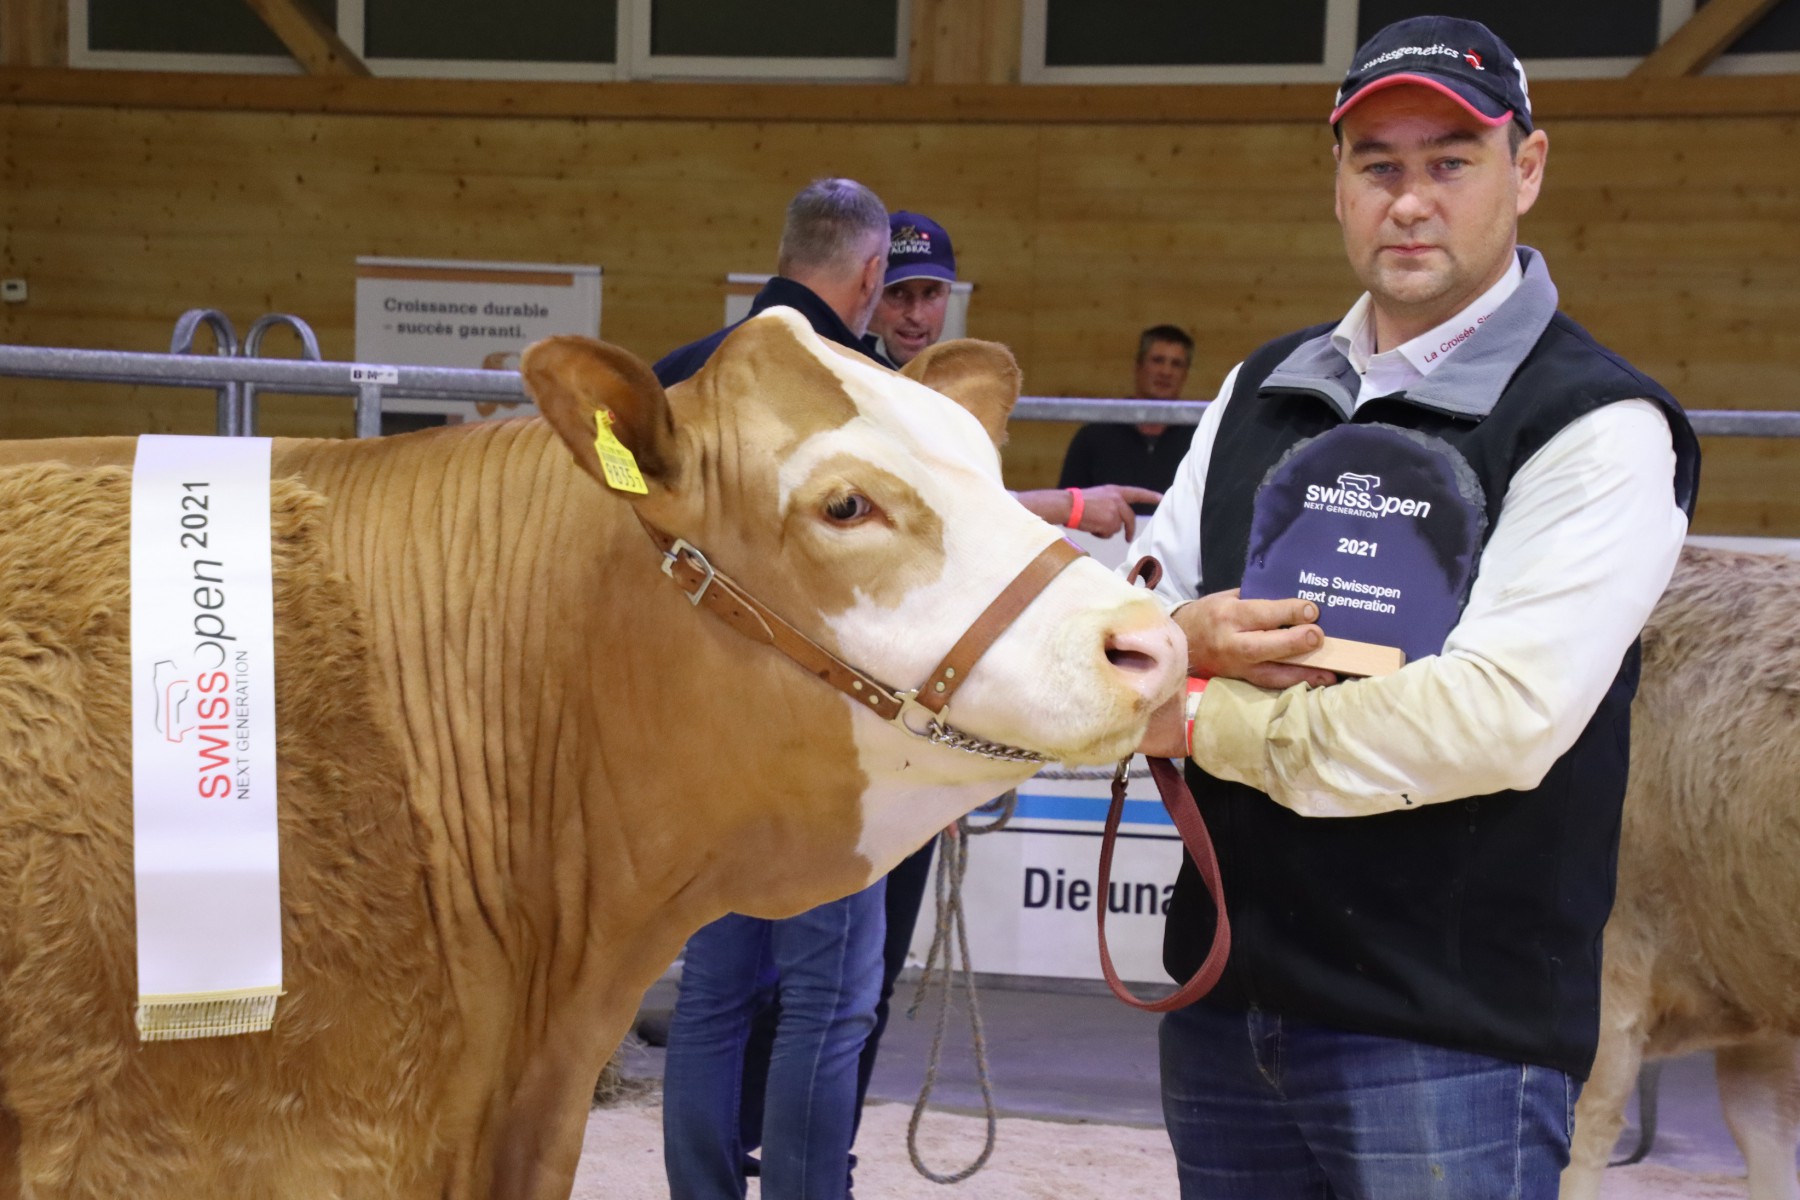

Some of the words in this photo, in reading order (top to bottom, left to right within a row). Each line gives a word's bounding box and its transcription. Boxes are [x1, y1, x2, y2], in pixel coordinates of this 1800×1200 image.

[384, 297, 478, 315] Croissance
[483, 301, 549, 318] durable
[397, 321, 453, 336] succès
[458, 324, 527, 340] garanti.
[1424, 351, 1438, 363] La
[180, 482, 210, 549] 2021
[1303, 501, 1324, 511] NEXT
[1325, 503, 1379, 519] GENERATION
[1336, 537, 1378, 557] 2021
[1299, 570, 1329, 587] Miss
[1331, 576, 1401, 599] Swissopen
[1298, 589, 1327, 603] next
[1327, 593, 1396, 614] generation
[235, 650, 251, 752] GENERATION
[236, 757, 251, 800] NEXT
[1023, 867, 1092, 912] Die
